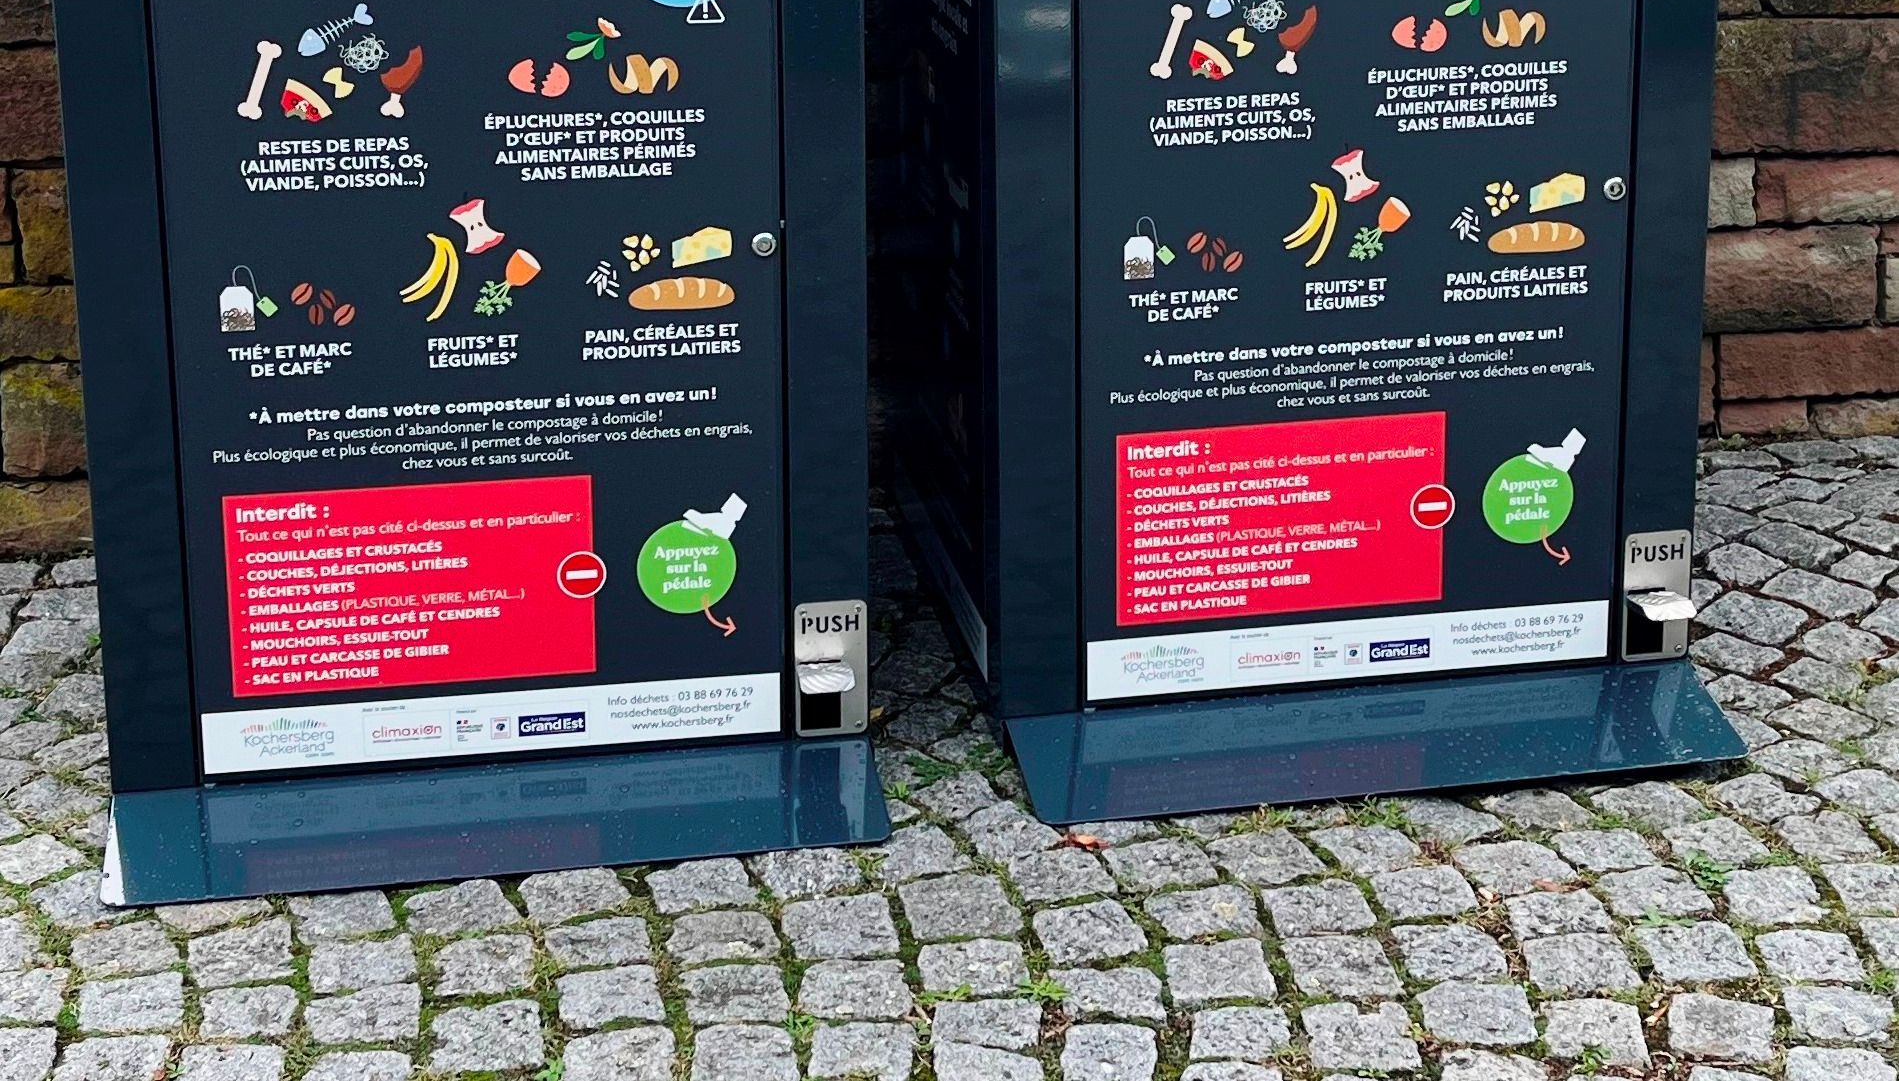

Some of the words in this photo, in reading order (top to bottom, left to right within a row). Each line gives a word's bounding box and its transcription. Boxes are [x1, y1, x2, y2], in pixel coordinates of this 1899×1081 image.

[1480, 60, 1567, 77] COQUILLES
[1166, 96, 1222, 112] RESTES
[1226, 94, 1247, 109] DE
[1251, 91, 1299, 107] REPAS
[610, 108, 705, 125] COQUILLES
[575, 130, 596, 144] ET
[599, 126, 685, 143] PRODUITS
[258, 139, 321, 155] RESTES
[326, 138, 350, 153] DE
[354, 136, 409, 152] REPAS
[495, 146, 619, 164] ALIMENTAIRES
[623, 141, 696, 159] PÉRIMÉS
[240, 156, 335, 176] (ALIMENTS
[339, 155, 395, 170] CUITS,
[398, 153, 428, 169] OS,
[521, 166, 567, 181] SANS
[570, 162, 672, 179] EMBALLAGE
[245, 175, 319, 191] VIANDE,
[323, 171, 424, 188] POISSON...)
[1446, 271, 1487, 286] PAIN,
[1489, 265, 1565, 283] CÉRÉALES
[1568, 265, 1587, 278] ET
[1443, 285, 1520, 302] PRODUITS
[1523, 280, 1588, 297] LAITIERS
[1147, 308, 1169, 322] DE
[498, 334, 518, 347] ET
[585, 328, 629, 343] PAIN,
[632, 323, 715, 341] CÉRÉALES
[718, 323, 739, 336] ET
[274, 344, 296, 358] ET
[299, 342, 352, 357] MARC
[582, 343, 667, 360] PRODUITS
[670, 339, 741, 356] LAITIERS
[250, 363, 275, 377] DE
[276, 408, 340, 423] mettre
[345, 404, 388, 419] dans
[392, 403, 440, 416] votre
[445, 397, 551, 416] composteur
[555, 393, 570, 408] si
[574, 394, 615, 407] vous
[619, 393, 640, 404] en
[644, 390, 684, 403] avez
[307, 428, 330, 441] Pas
[333, 425, 391, 442] question
[395, 421, 489, 436] d'abandonner
[491, 418, 504, 431] le
[507, 416, 587, 432] compostage
[591, 412, 599, 425] à
[1499, 478, 1558, 494] Appuyez
[1509, 494, 1532, 506] sur
[1534, 493, 1547, 504] la
[235, 502, 317, 523] Interdit
[1505, 508, 1550, 524] pédale
[245, 547, 343, 564] COQUILLAGES
[345, 546, 363, 557] ET
[364, 539, 442, 556] CRUSTACÉS
[654, 545, 720, 560] Appuyez
[1631, 544, 1684, 563] PUSH
[666, 563, 692, 574] sur
[693, 560, 708, 572] la
[662, 575, 711, 593] pédale
[1133, 602, 1158, 614] SAC
[1160, 600, 1178, 612] EN
[1180, 595, 1246, 610] PLASTIQUE
[801, 614, 860, 635] PUSH
[250, 634, 341, 650] MOUCHOIRS,
[343, 628, 429, 644] ESSUIE-TOUT
[607, 695, 627, 705] Info
[630, 694, 669, 704] déchets
[677, 690, 690, 701] 03
[693, 689, 707, 700] 88
[709, 688, 722, 699] 69
[725, 687, 737, 697] 76
[740, 686, 753, 696] 29
[610, 699, 751, 718] nosdechets@kochersberg.fr
[631, 713, 734, 730] www.kochersberg.fr
[244, 729, 334, 747] Kochersberg
[259, 742, 326, 758] Ackerland
